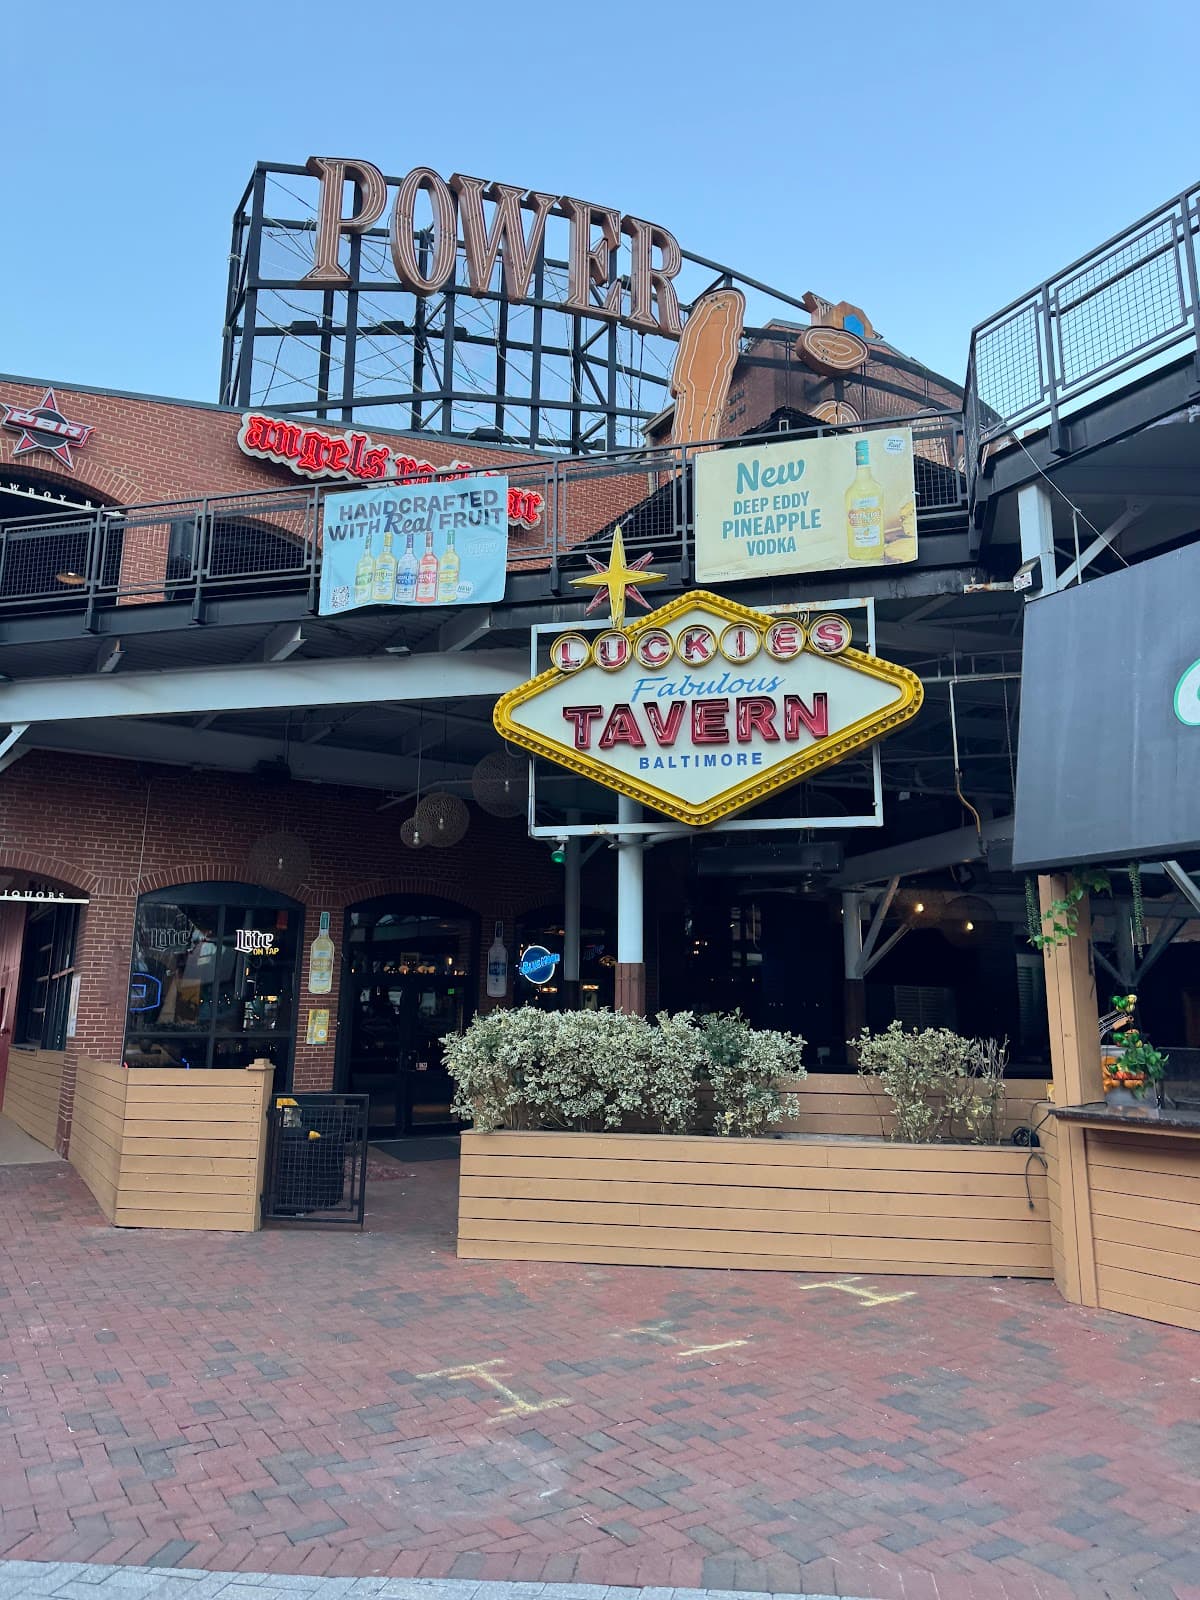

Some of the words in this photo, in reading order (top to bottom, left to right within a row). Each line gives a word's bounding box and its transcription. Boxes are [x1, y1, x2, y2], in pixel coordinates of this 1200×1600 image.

[300, 156, 684, 337] POWER
[10, 412, 82, 438] PBR
[736, 459, 805, 494] New
[0, 481, 66, 502] WBOY
[339, 489, 499, 521] HANDCRAFTED
[733, 497, 769, 515] DEEP
[773, 490, 810, 511] EDDY
[328, 518, 381, 541] WITH
[384, 508, 435, 535] Real
[439, 508, 506, 530] FRUIT
[722, 508, 822, 539] PINEAPPLE
[746, 536, 797, 556] VODKA
[560, 622, 843, 669] LUCKIES
[631, 672, 786, 702] Fabulous
[562, 692, 829, 750] TAVERN
[639, 752, 763, 769] BALTIMORE
[2, 889, 65, 900] IQUORS
[234, 929, 273, 953] Lite
[253, 947, 263, 956] ON
[264, 947, 280, 956] TAP
